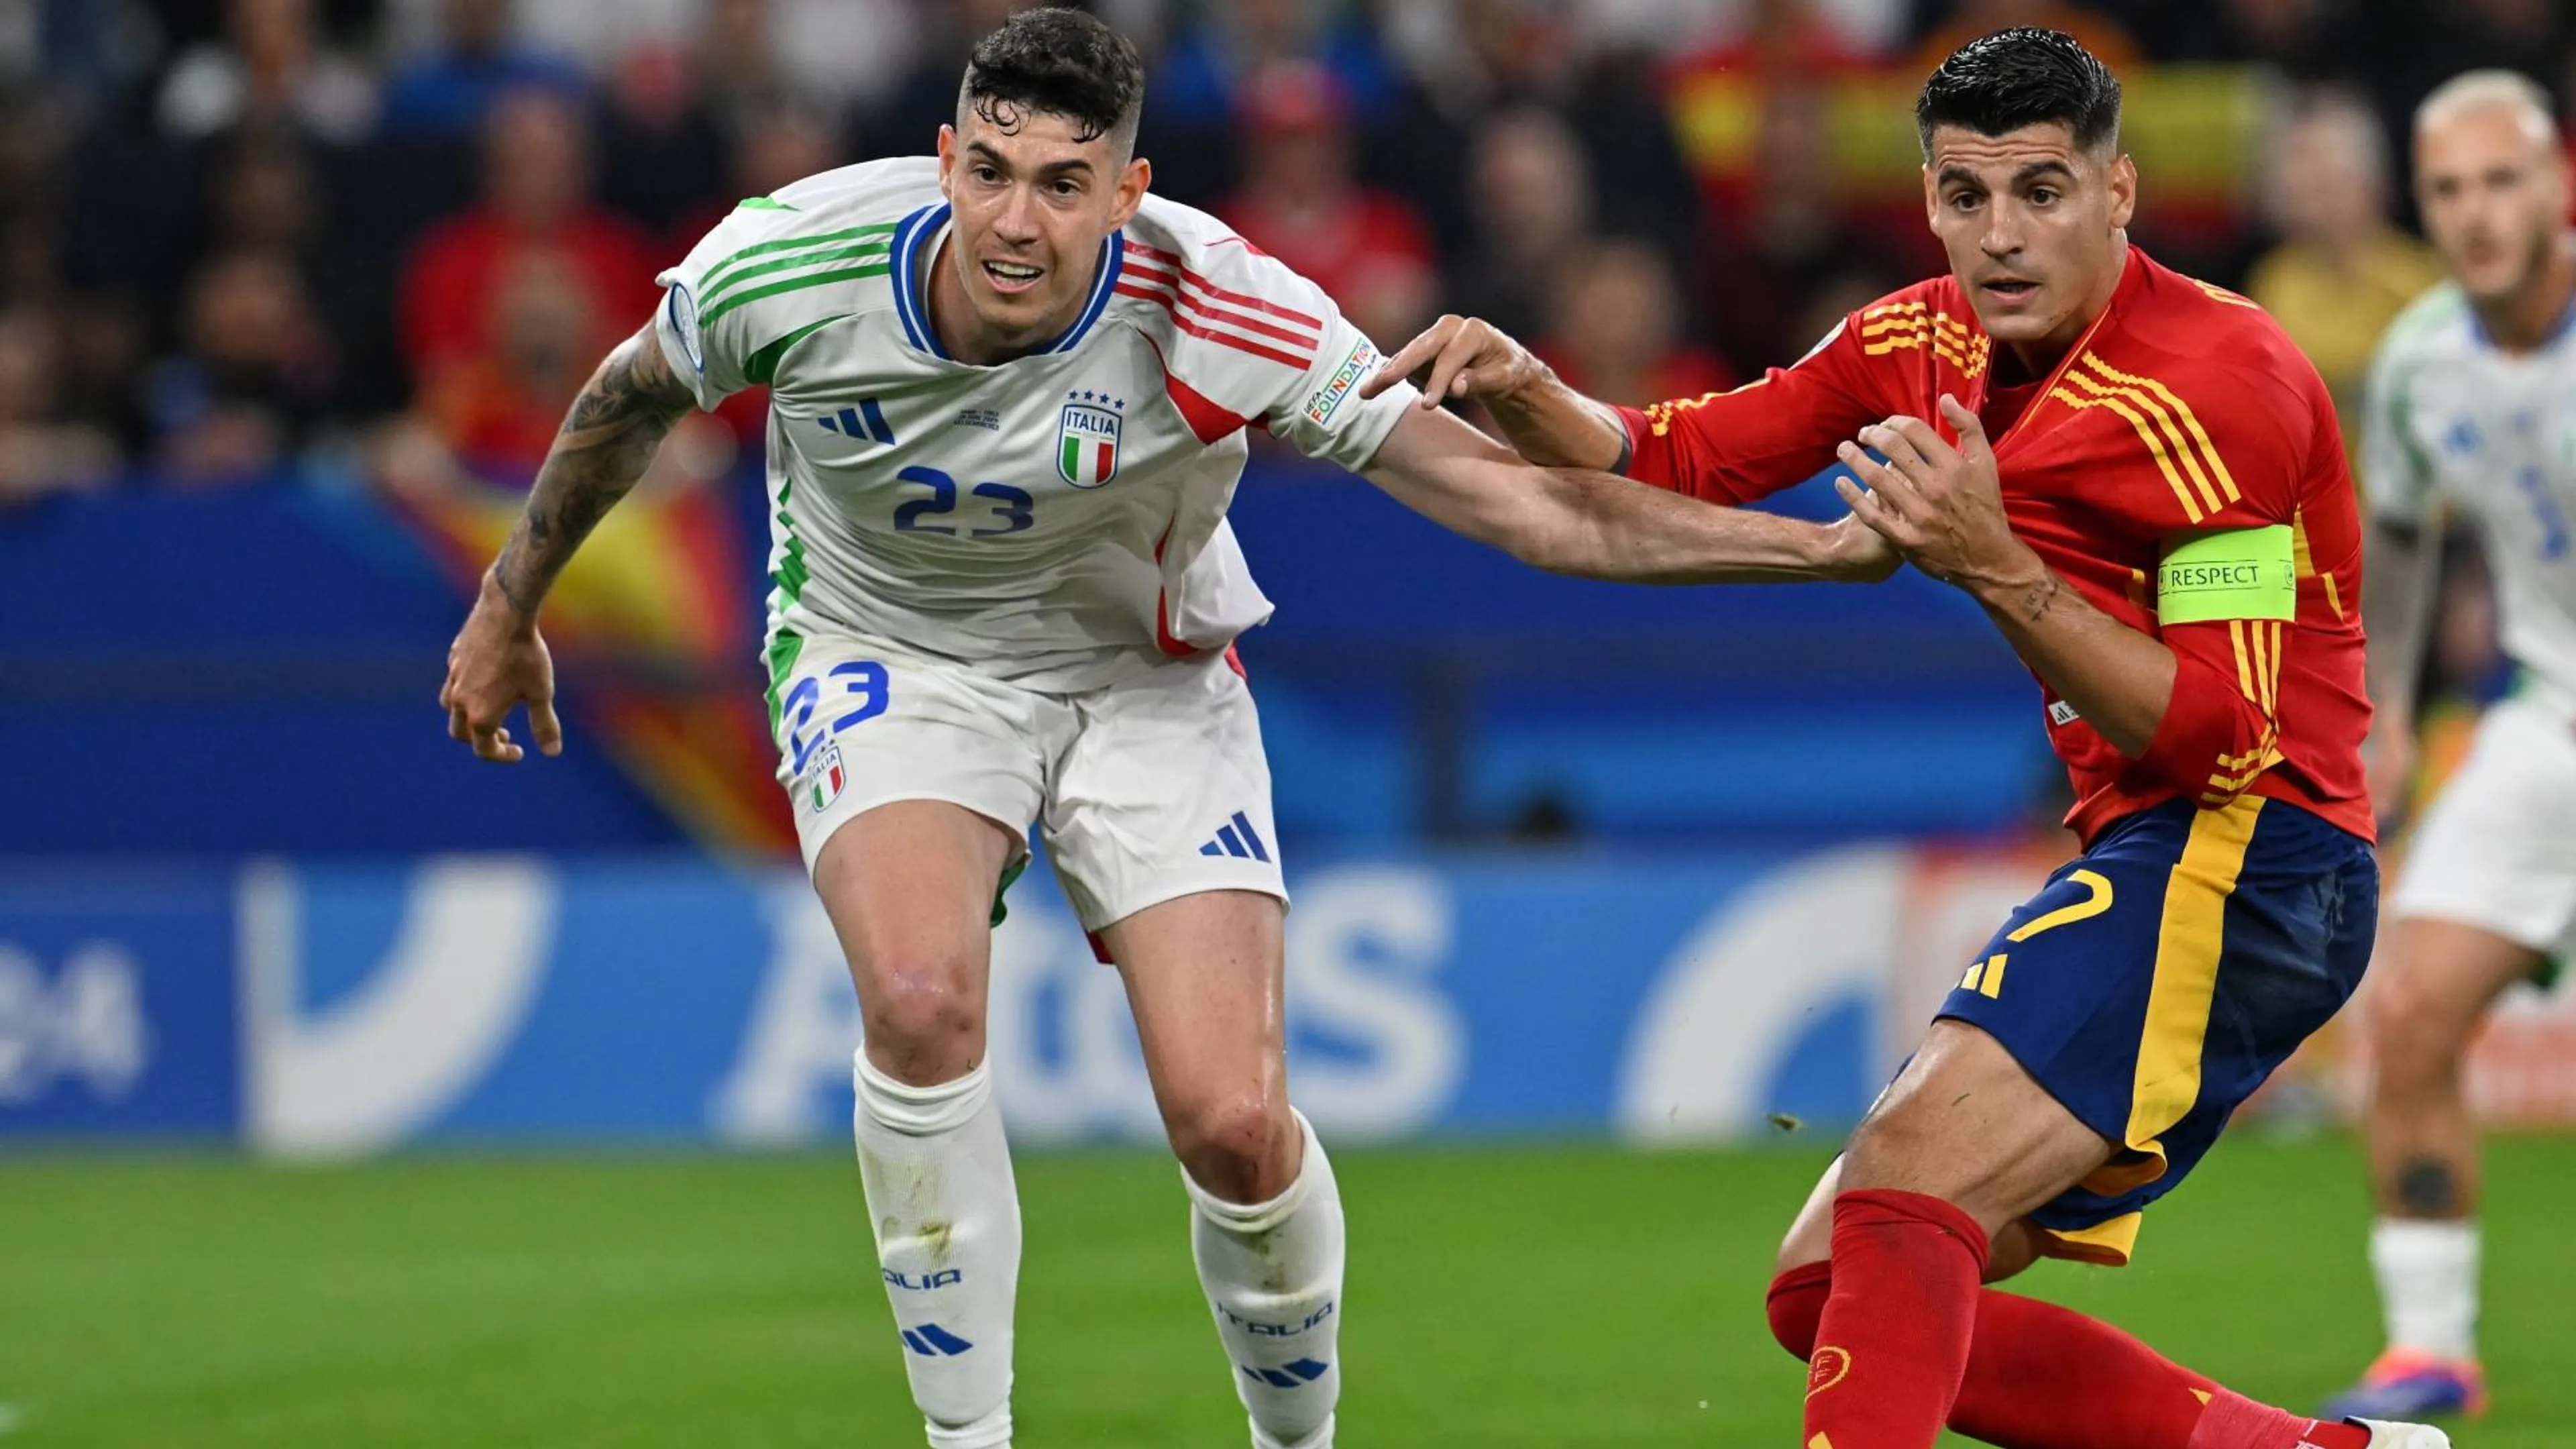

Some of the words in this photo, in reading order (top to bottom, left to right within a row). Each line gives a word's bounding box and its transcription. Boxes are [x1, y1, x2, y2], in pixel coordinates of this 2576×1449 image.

[1311, 341, 1370, 423] FOUNDATION
[1067, 411, 1114, 435] ITALIA
[894, 466, 1034, 537] 23
[2171, 566, 2259, 587] RESPECT
[784, 661, 890, 776] 23
[2006, 868, 2113, 943] 7
[1217, 1301, 1332, 1336] ITALIA
